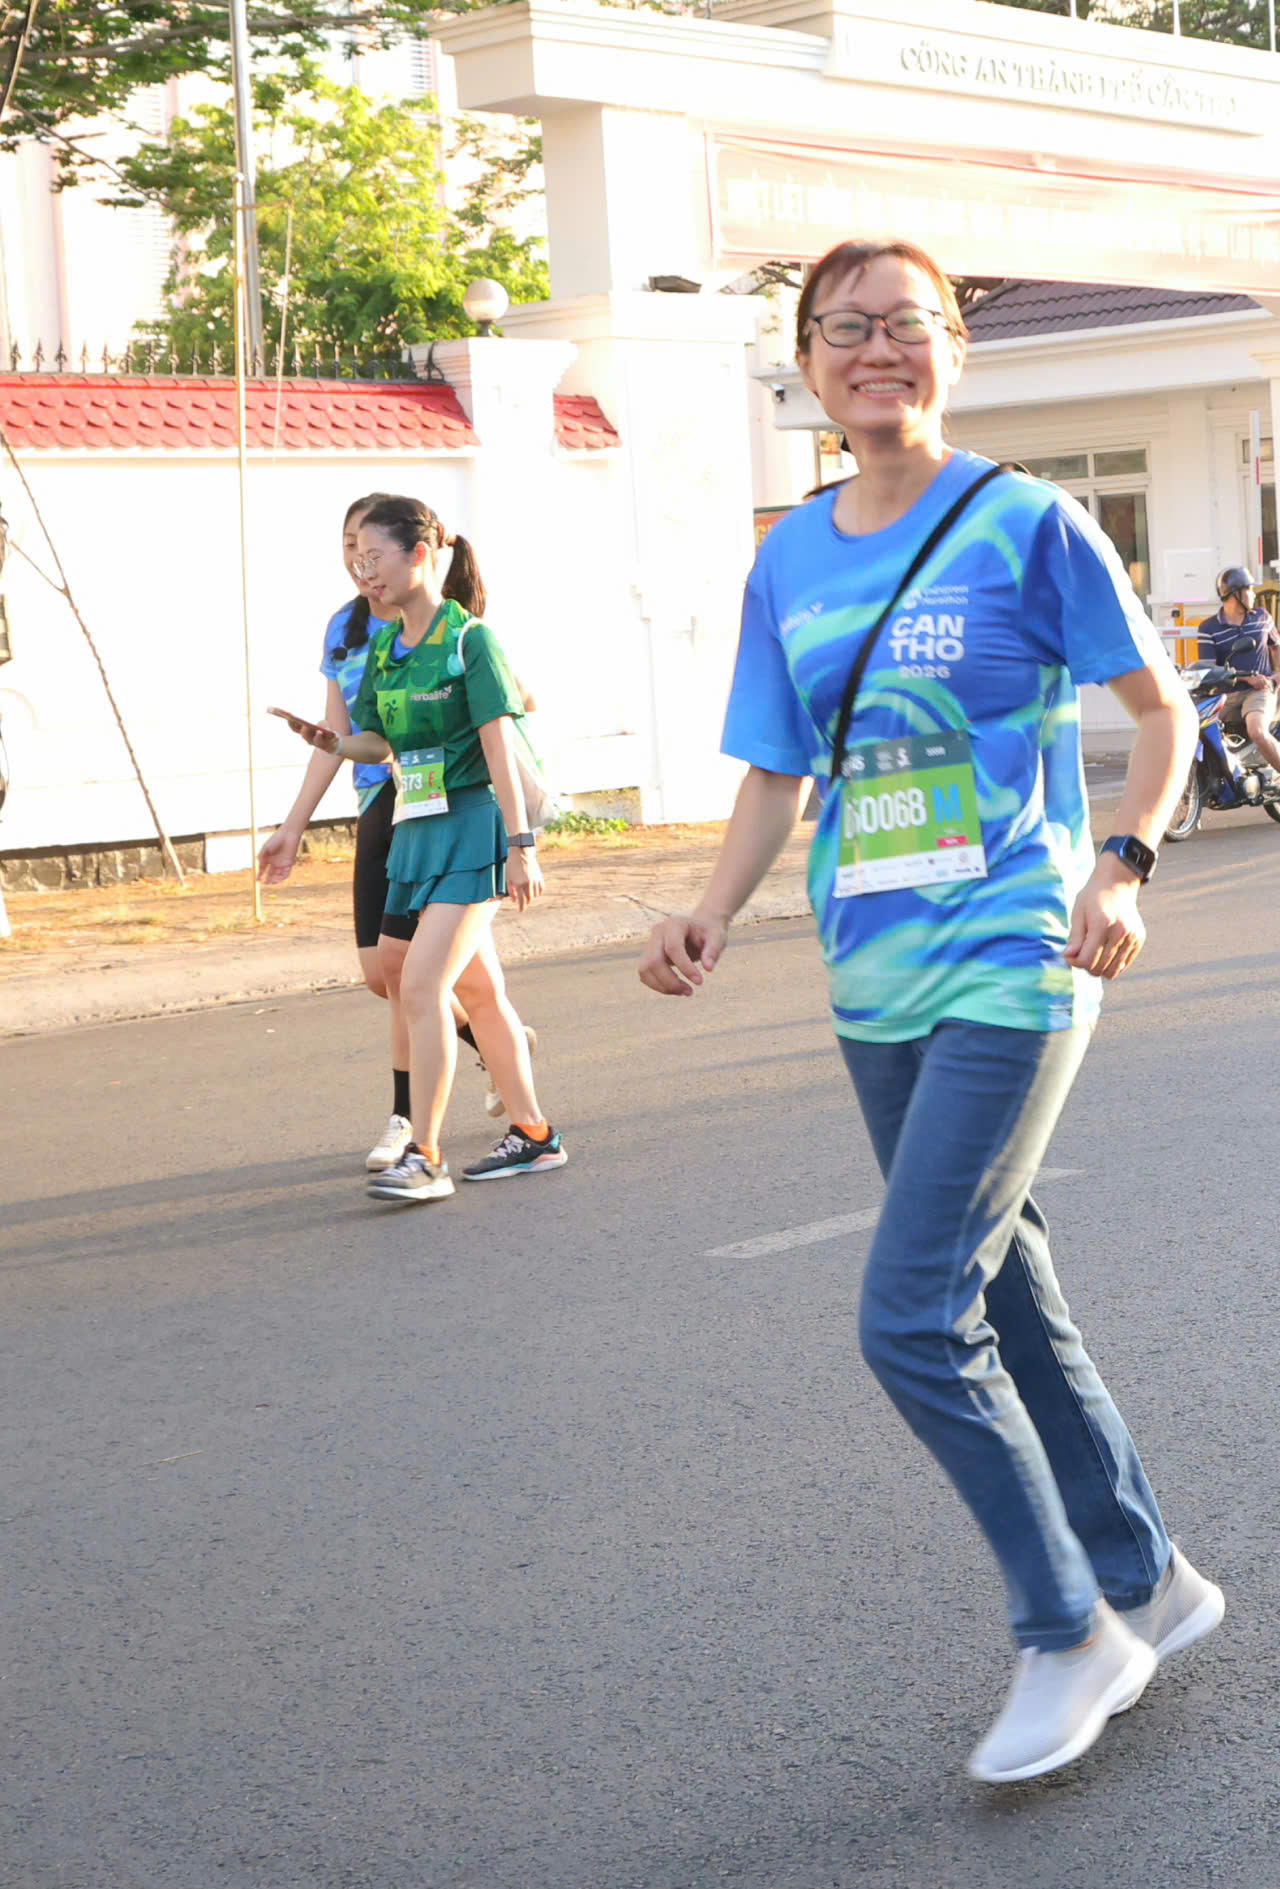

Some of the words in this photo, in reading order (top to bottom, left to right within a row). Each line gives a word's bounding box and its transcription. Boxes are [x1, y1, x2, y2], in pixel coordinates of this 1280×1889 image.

[975, 56, 1008, 86] AN
[891, 614, 965, 638] CAN
[888, 636, 966, 662] THO
[898, 664, 951, 680] 2026
[931, 783, 964, 825] M
